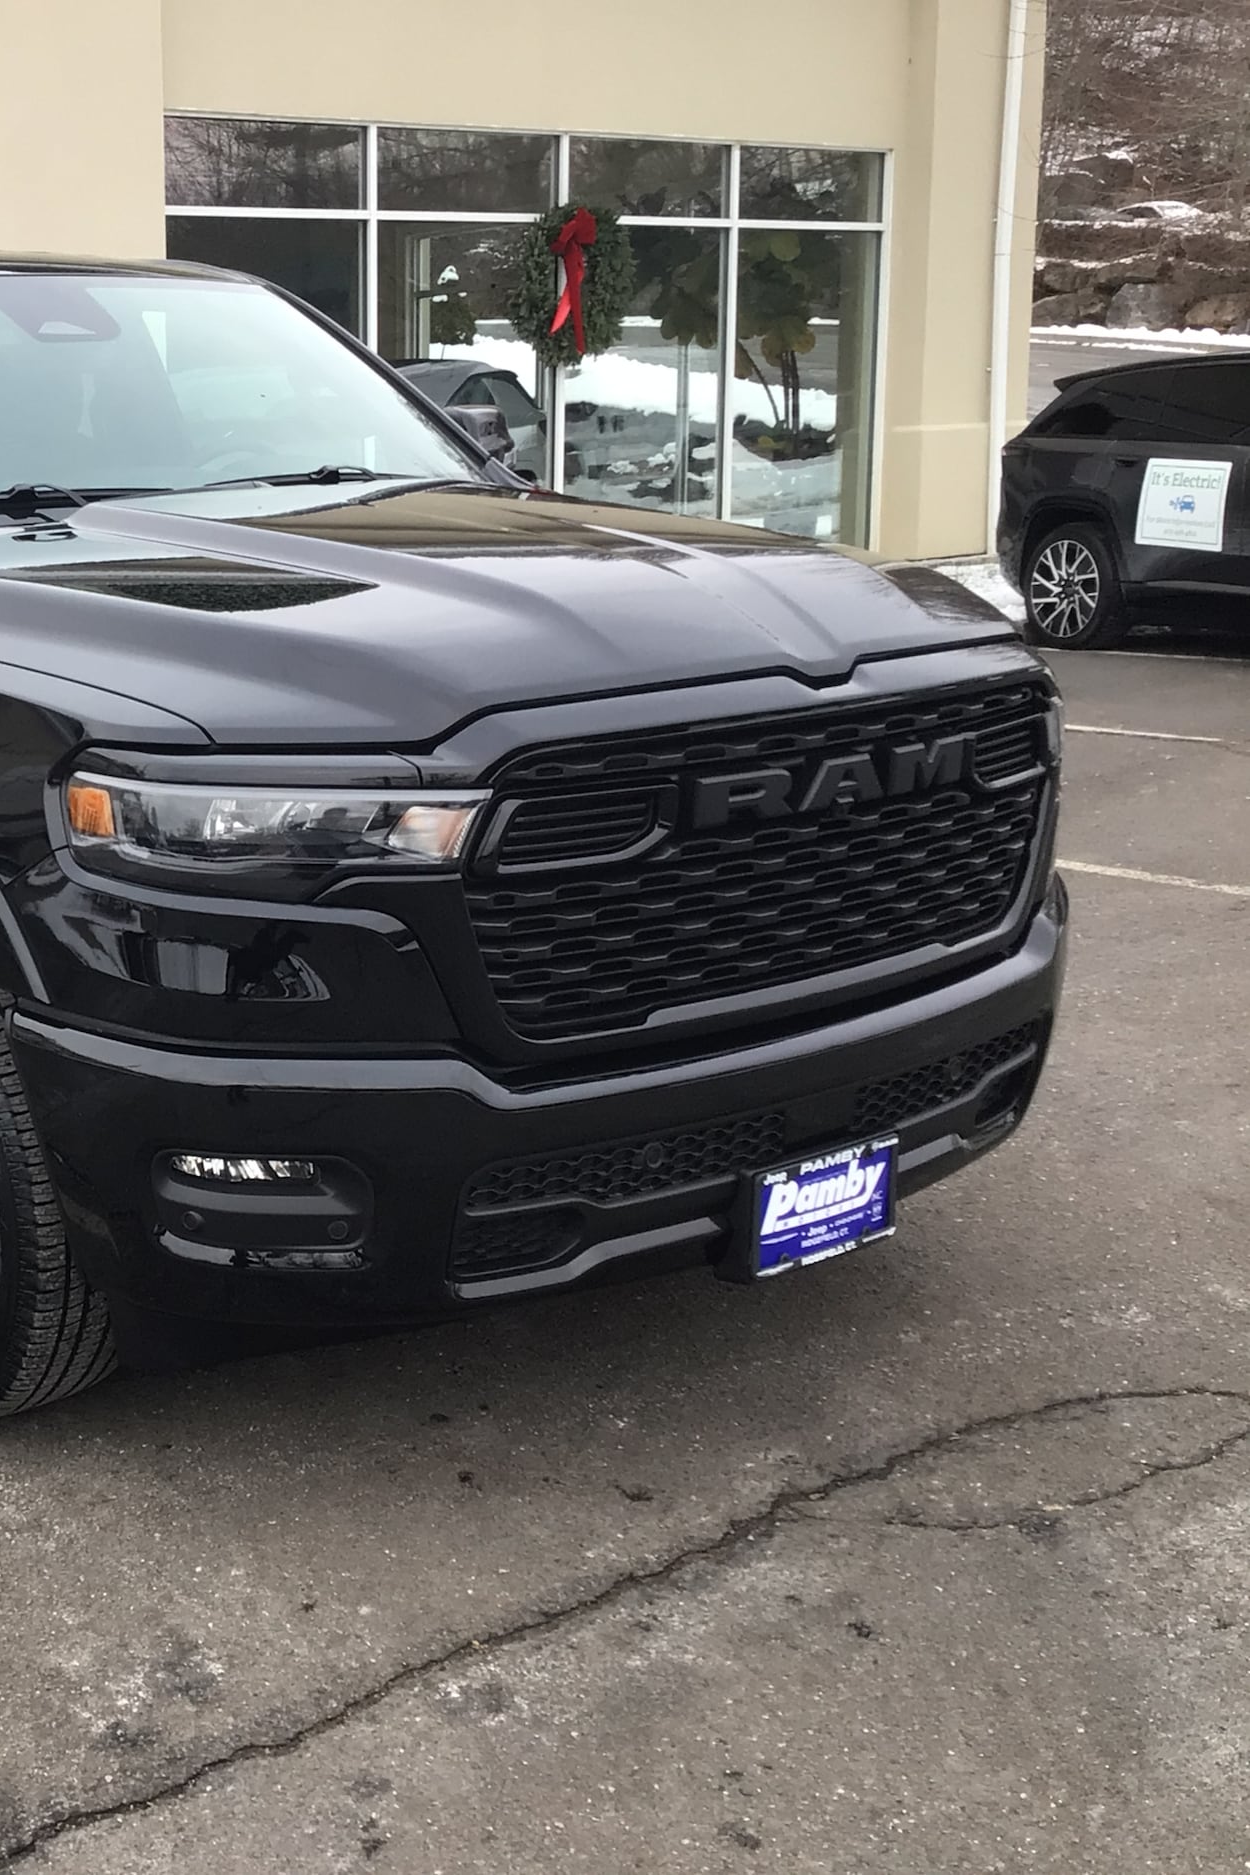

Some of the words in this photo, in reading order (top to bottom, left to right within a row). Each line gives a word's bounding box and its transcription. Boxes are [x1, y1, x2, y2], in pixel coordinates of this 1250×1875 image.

[1151, 472, 1170, 486] It's
[1172, 472, 1221, 489] Electric!
[694, 734, 967, 829] RAM
[800, 1145, 866, 1176] PAMBY
[760, 1159, 886, 1236] Pamby
